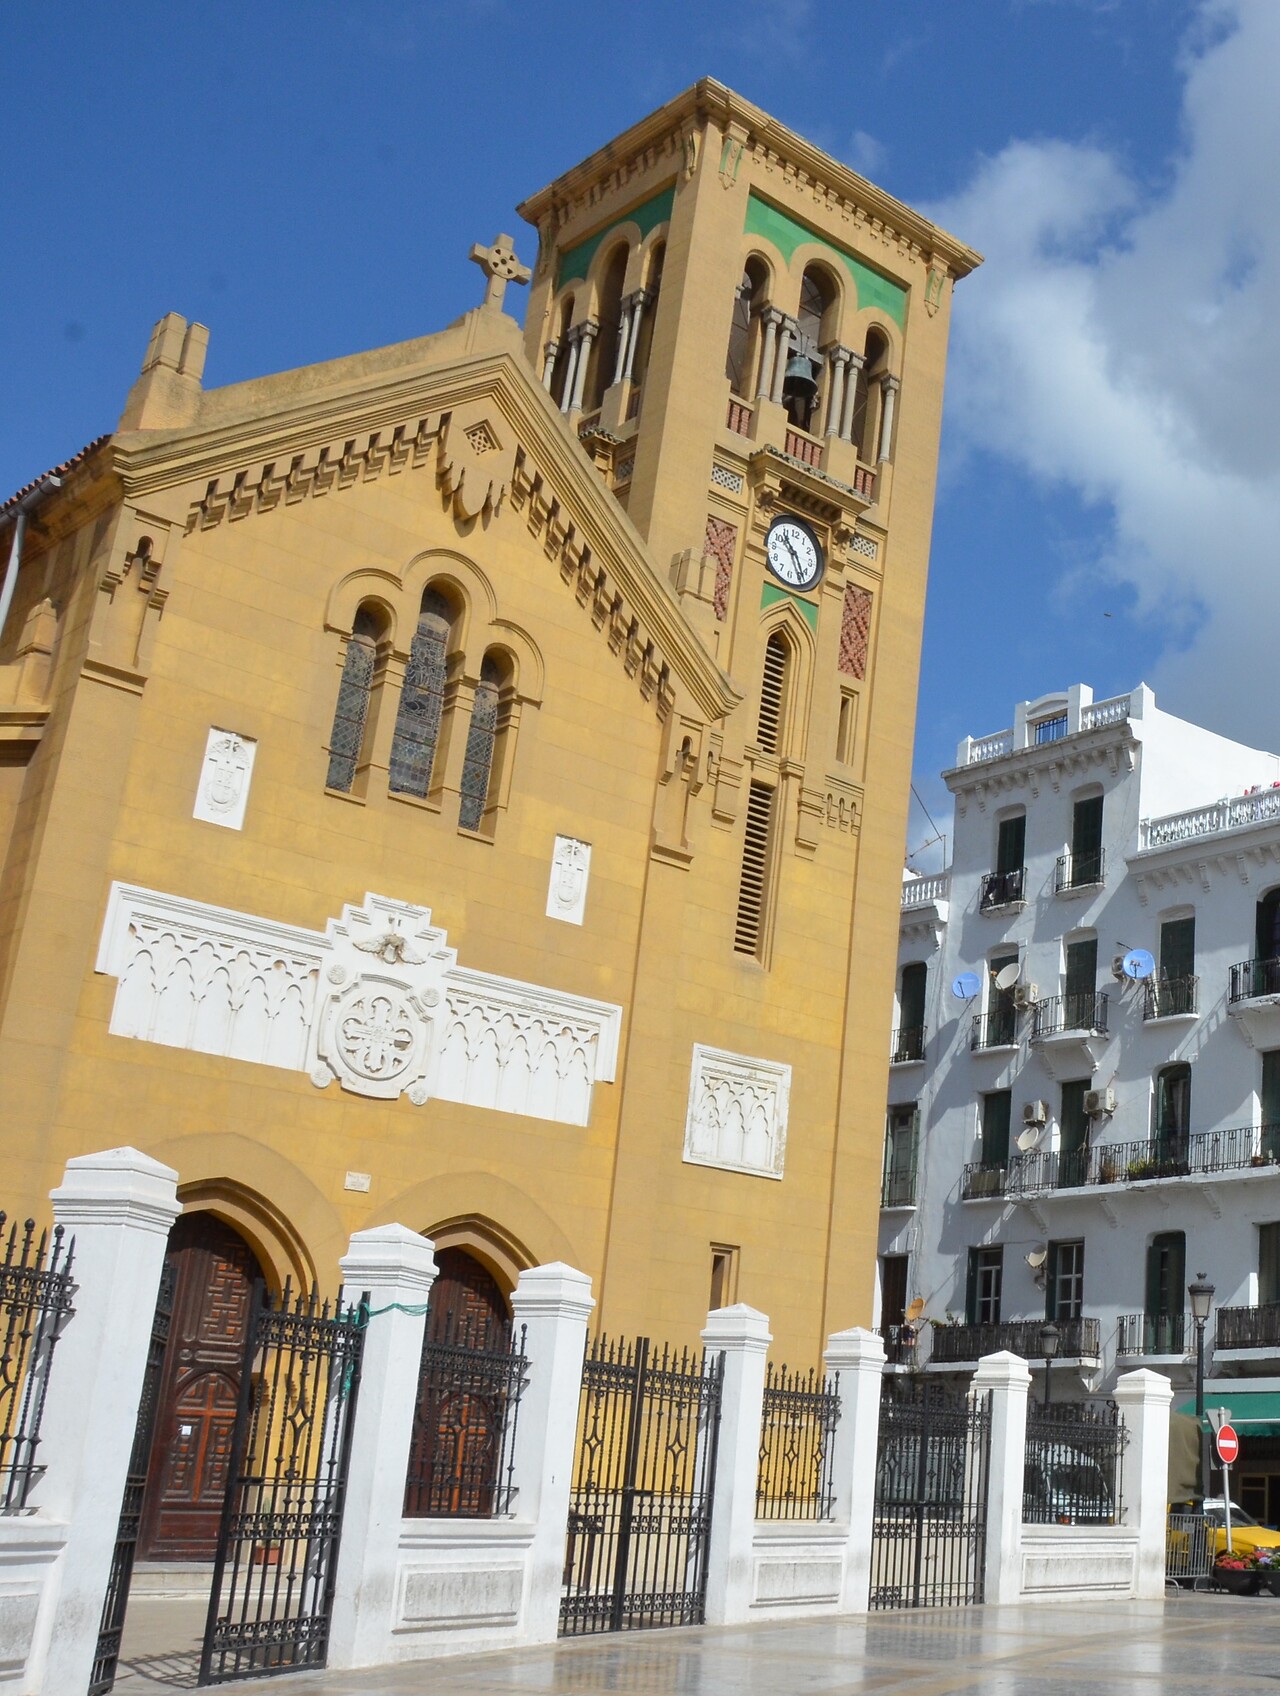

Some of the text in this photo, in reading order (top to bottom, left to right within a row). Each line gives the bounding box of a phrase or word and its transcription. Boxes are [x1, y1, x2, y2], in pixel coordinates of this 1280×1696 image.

[775, 533, 784, 542] 10
[791, 529, 800, 540] 12
[802, 537, 805, 546] 1
[806, 547, 812, 555] 2
[773, 553, 779, 561] 8
[780, 563, 784, 571] 7
[808, 559, 813, 567] 3
[787, 571, 793, 579] 6
[803, 568, 808, 576] 4
